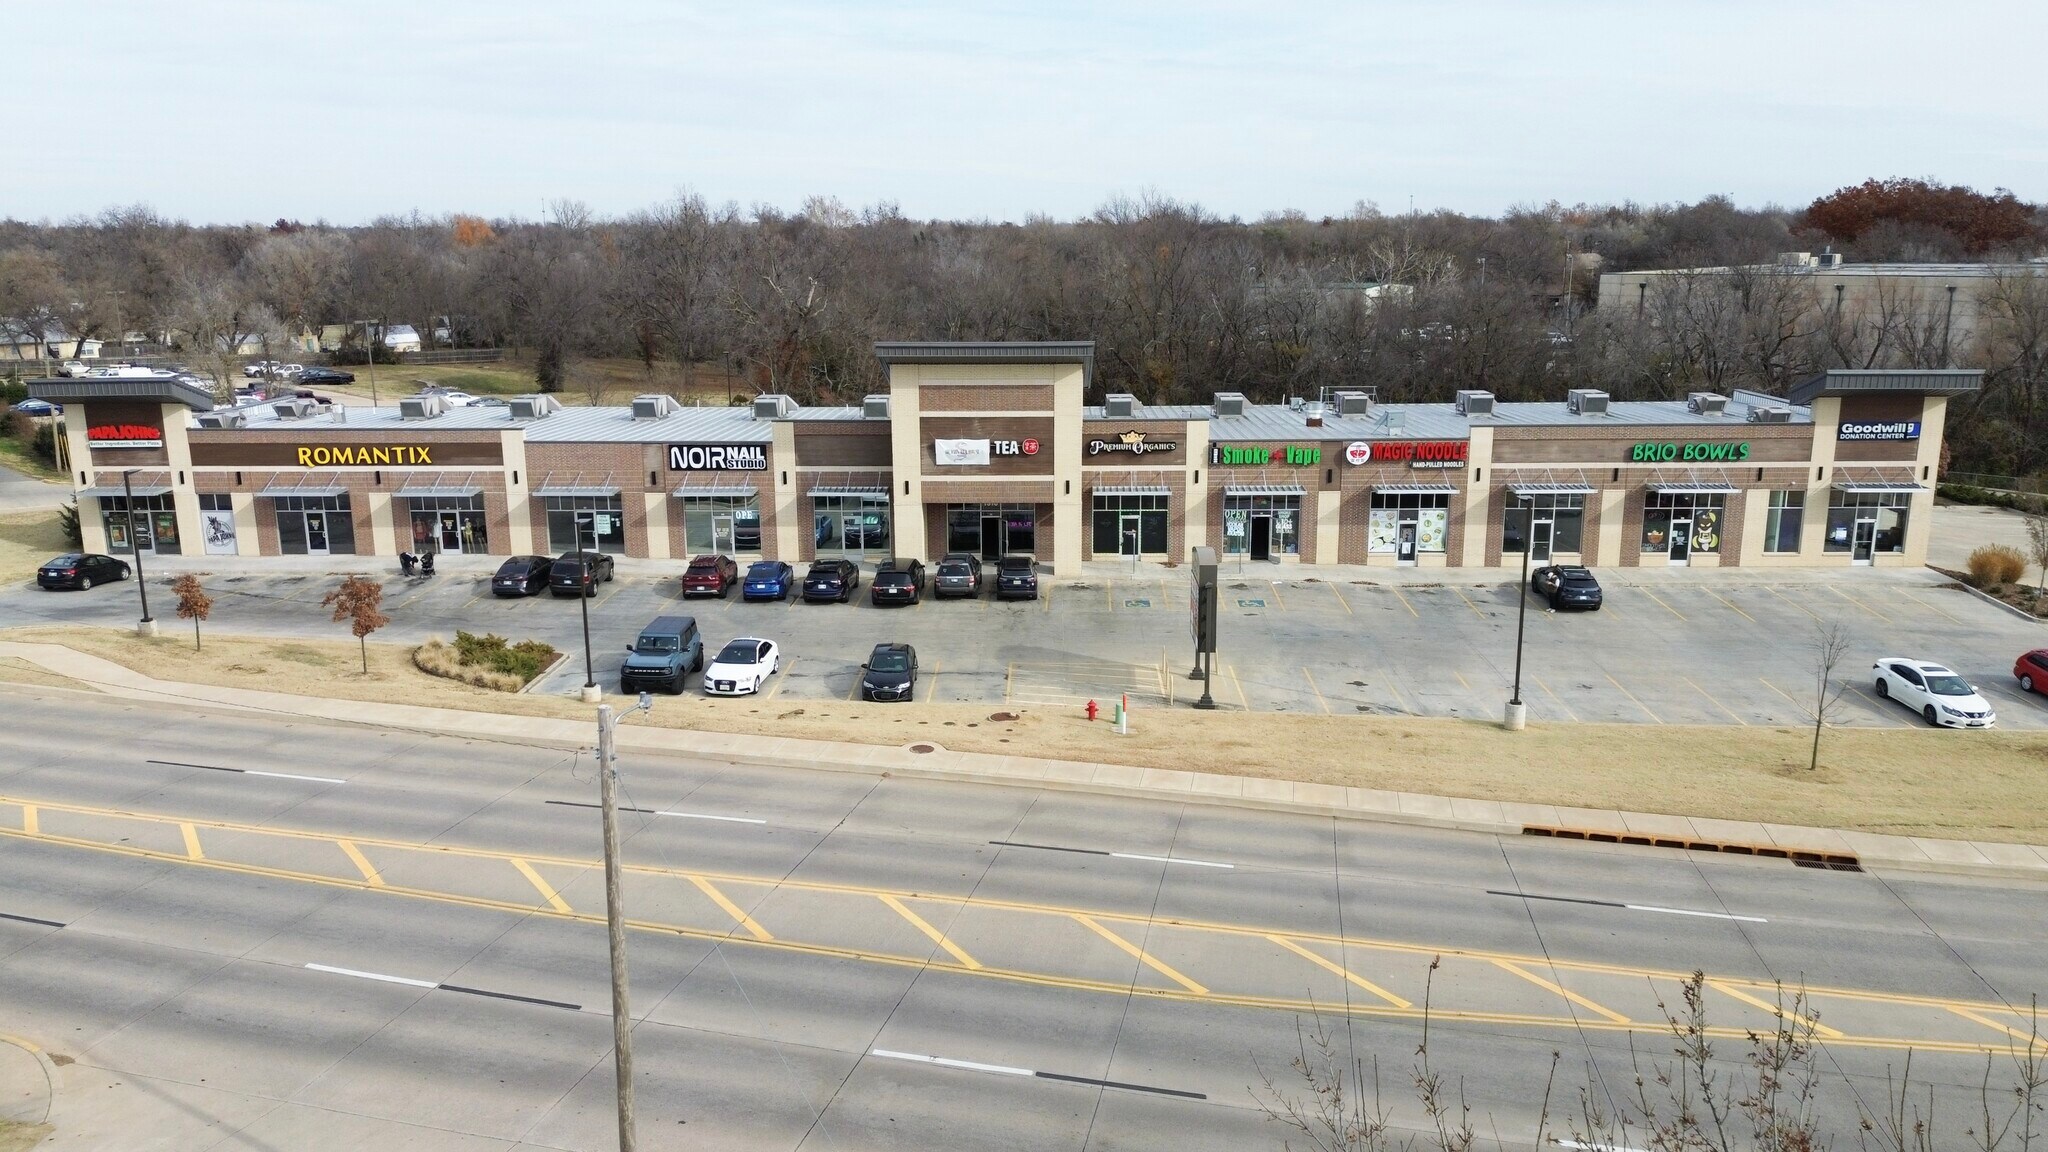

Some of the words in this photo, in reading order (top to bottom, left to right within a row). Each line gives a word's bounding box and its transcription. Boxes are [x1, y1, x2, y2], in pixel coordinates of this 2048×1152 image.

[88, 425, 119, 439] PAPA
[1842, 423, 1906, 433] Goodwill
[994, 440, 1019, 455] TEA
[1223, 444, 1269, 465] Smoke
[1286, 444, 1321, 466] Vape
[1372, 442, 1413, 461] MAGIC
[1416, 441, 1469, 460] NOODLE
[1632, 442, 1677, 461] BRIO
[1682, 442, 1750, 461] BOWLS
[297, 446, 433, 468] ROMANTIX
[670, 446, 727, 469] NOIR
[726, 446, 765, 459] NAIL
[727, 459, 766, 469] STUDIO
[1225, 510, 1247, 518] OPEN
